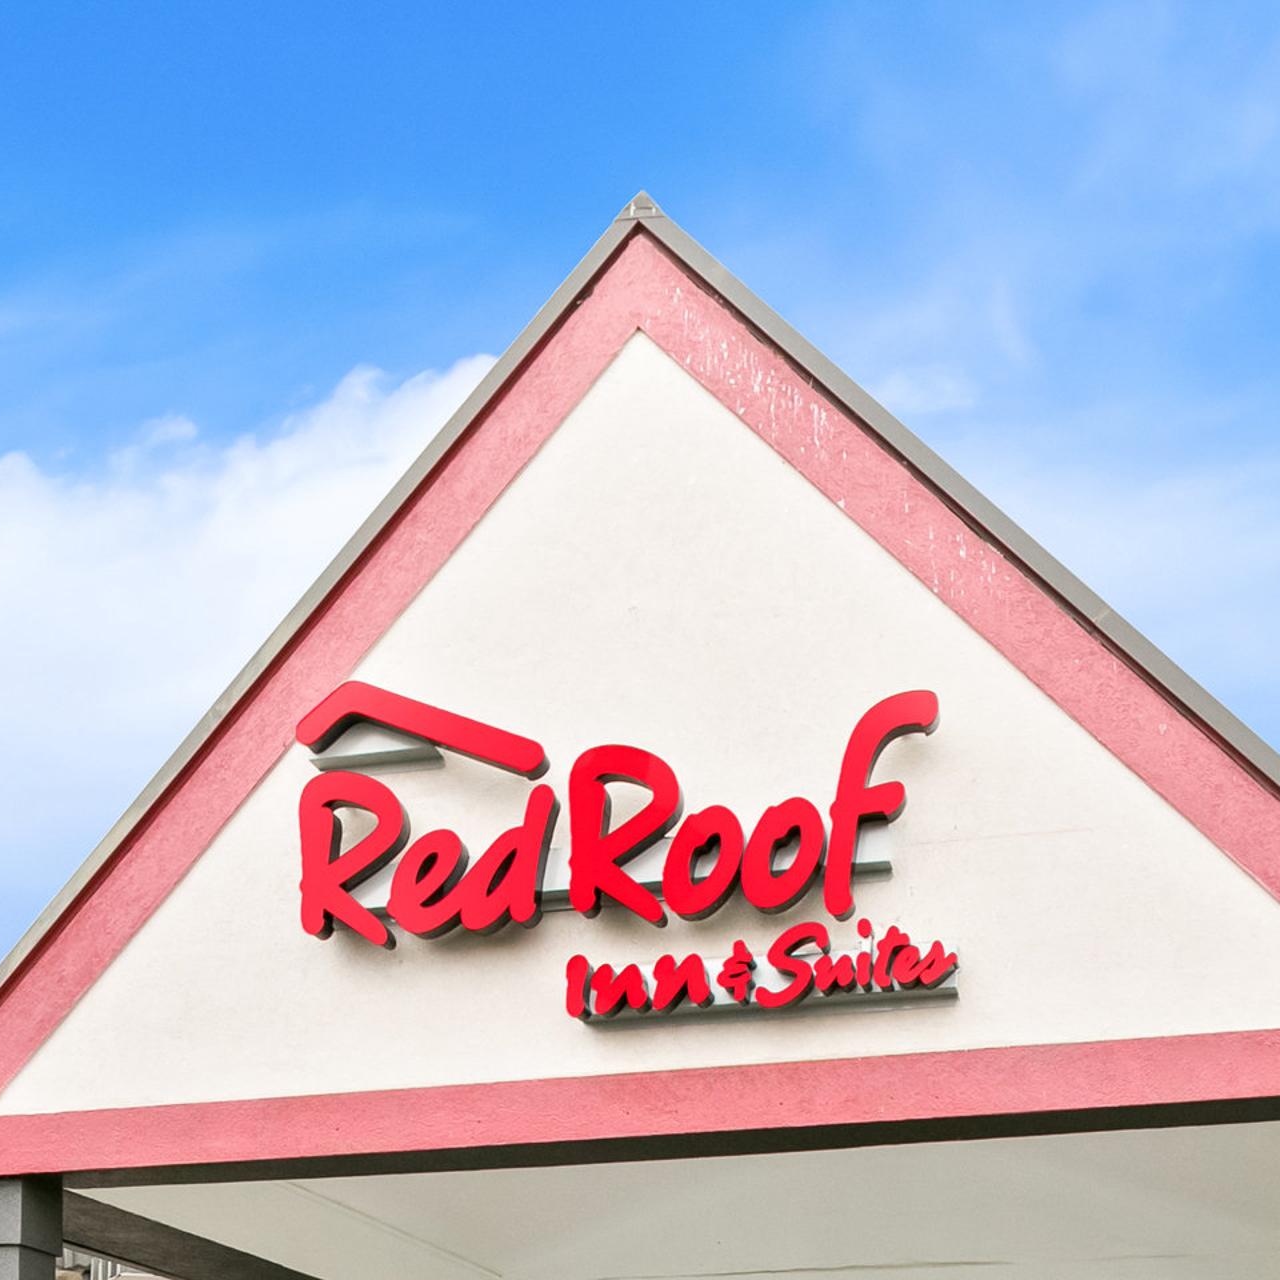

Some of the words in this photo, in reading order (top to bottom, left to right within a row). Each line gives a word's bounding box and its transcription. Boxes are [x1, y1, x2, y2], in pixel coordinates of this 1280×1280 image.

[299, 770, 559, 948] Red
[569, 690, 939, 927] Roof
[566, 953, 712, 1019] Inn
[755, 919, 958, 1009] Suites
